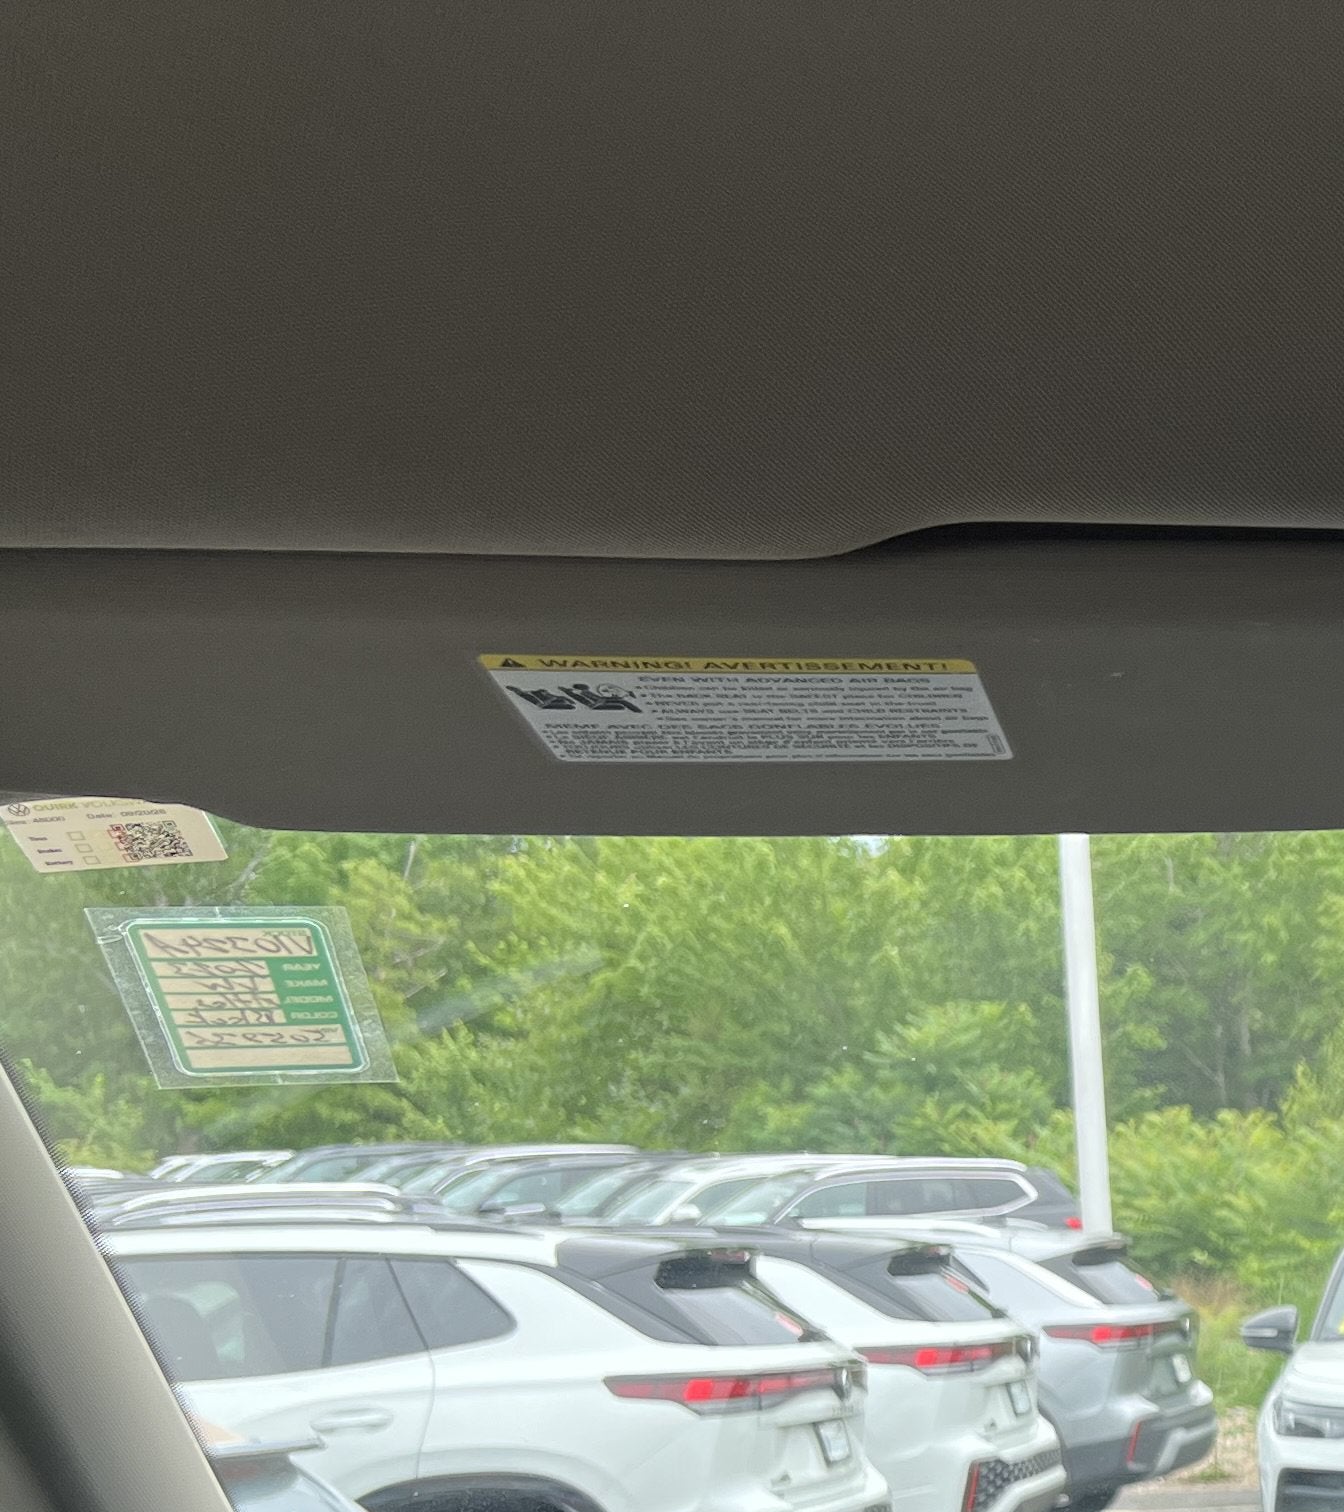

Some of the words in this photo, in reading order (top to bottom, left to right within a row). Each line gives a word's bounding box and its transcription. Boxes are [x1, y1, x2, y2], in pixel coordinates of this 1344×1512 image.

[539, 659, 693, 671] WARNING!
[703, 661, 948, 672] AVERTISSEMENT!
[33, 802, 78, 812] QUIRK
